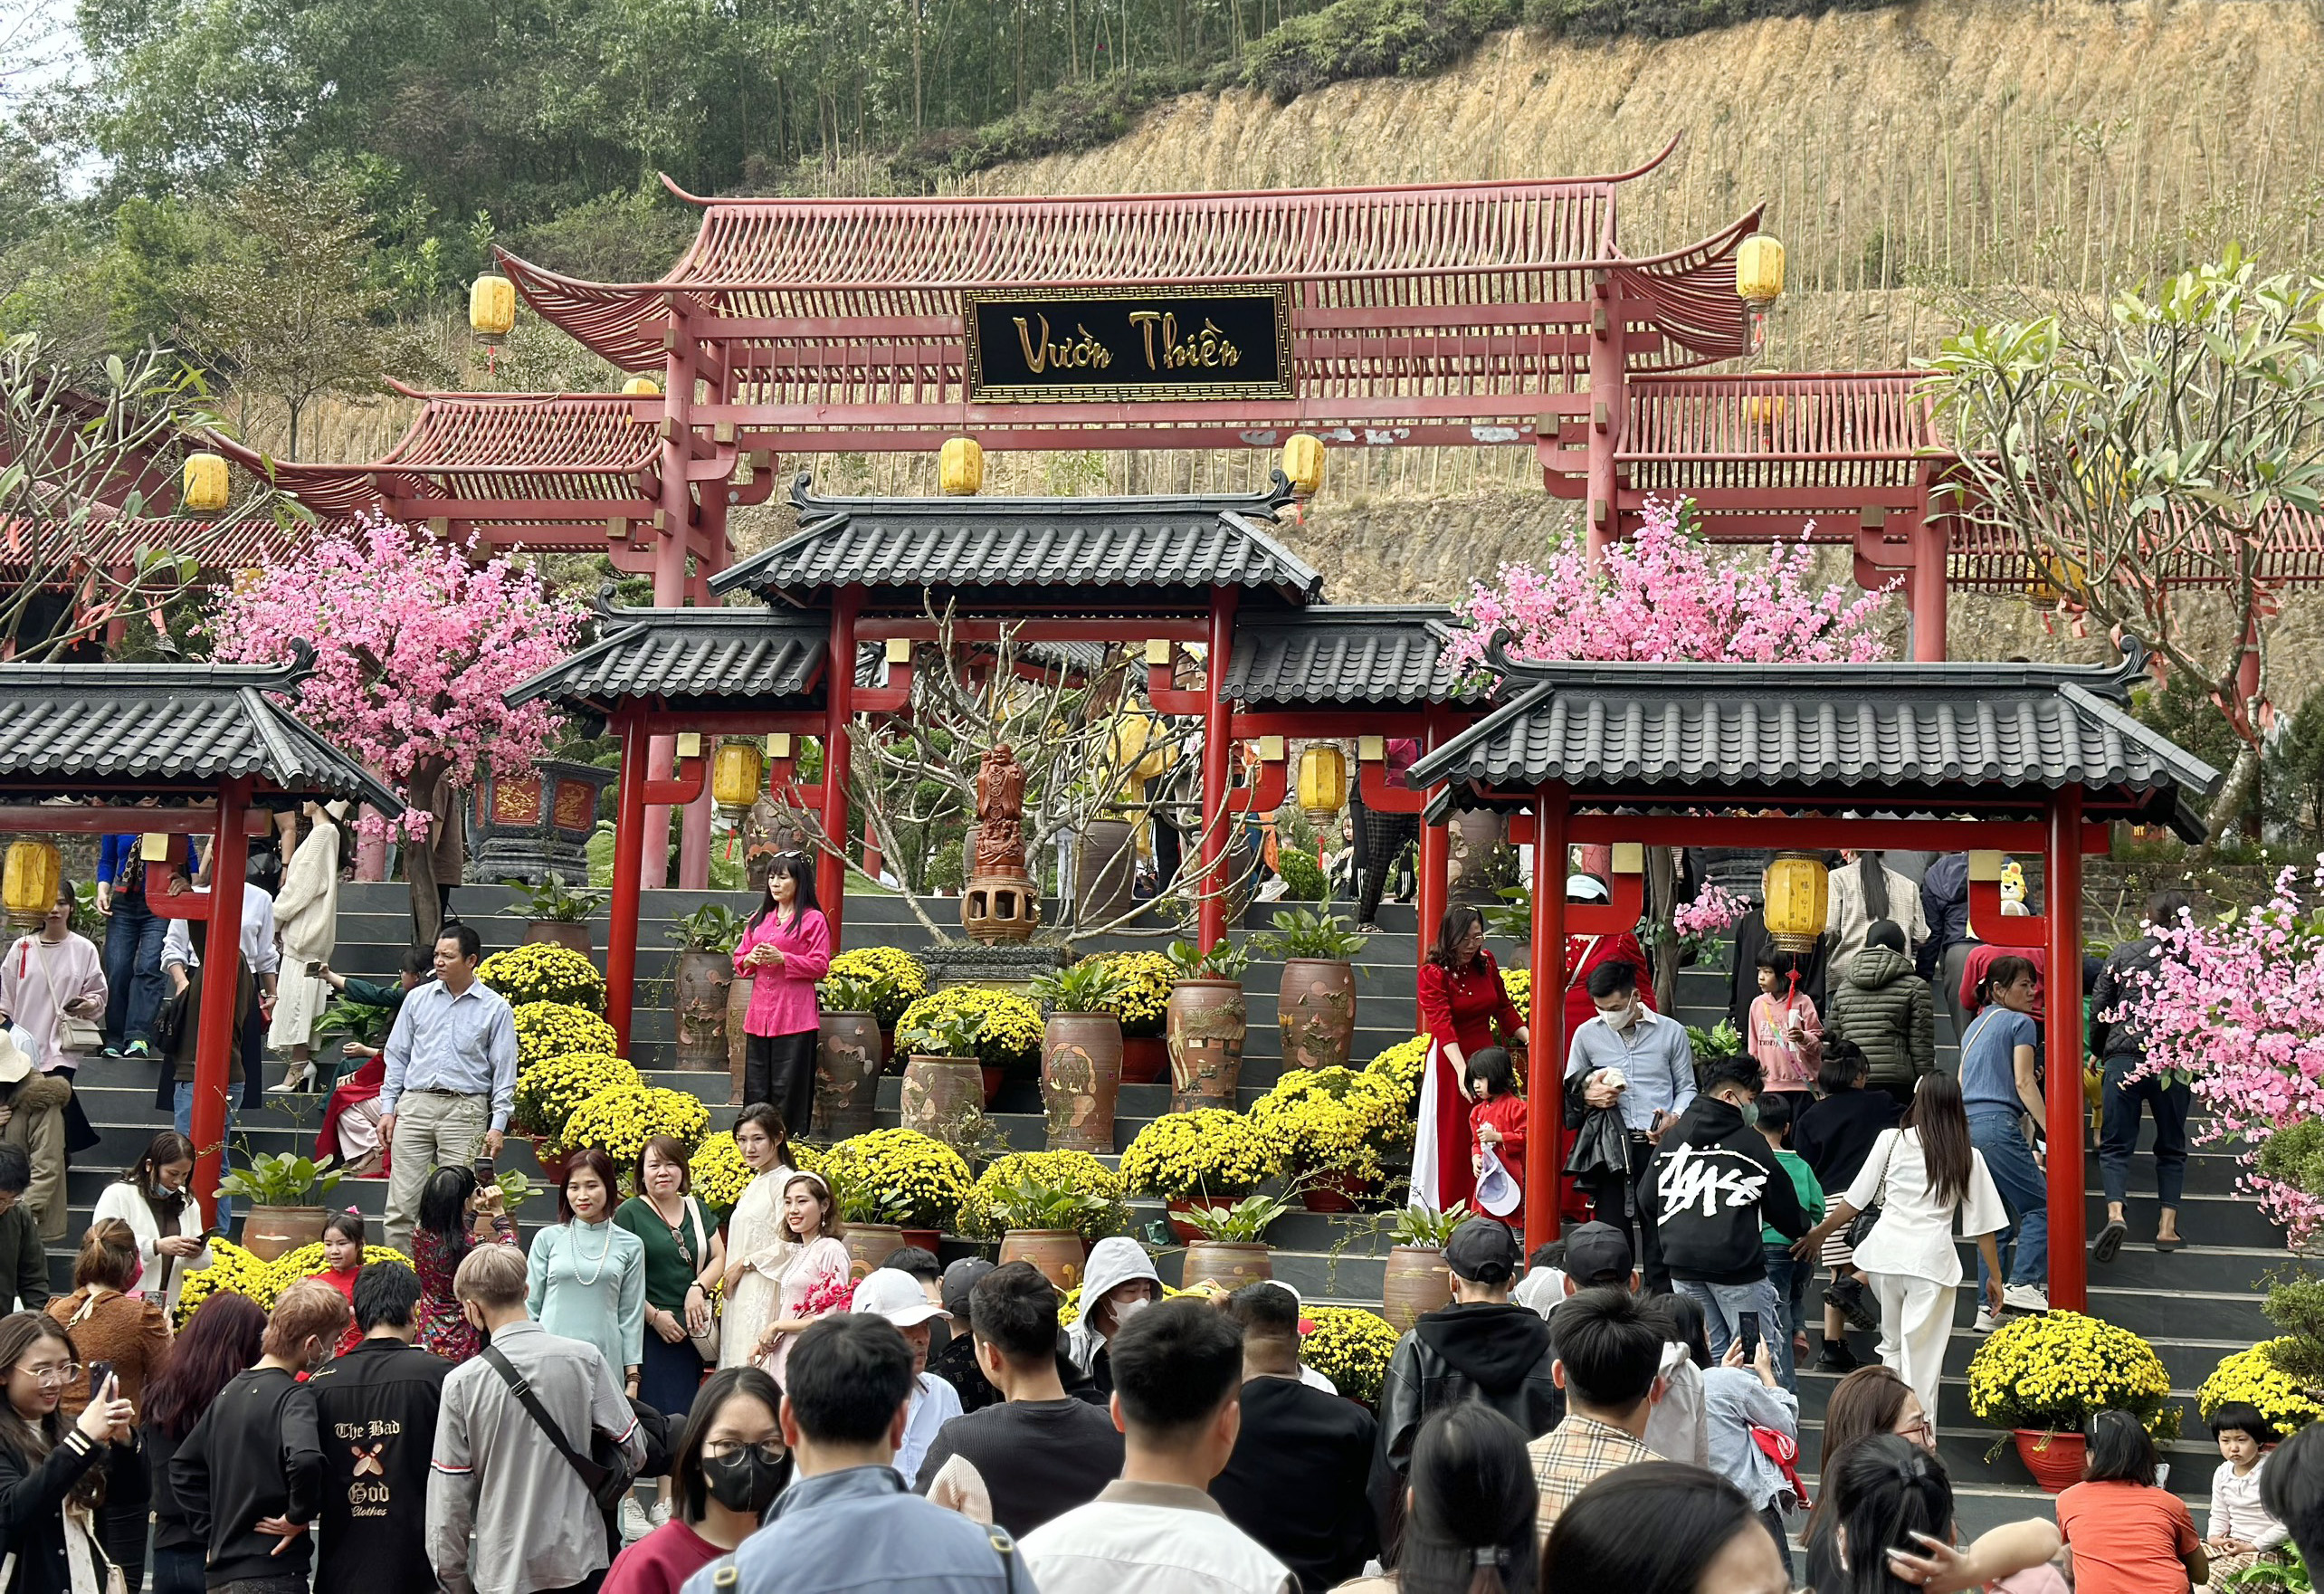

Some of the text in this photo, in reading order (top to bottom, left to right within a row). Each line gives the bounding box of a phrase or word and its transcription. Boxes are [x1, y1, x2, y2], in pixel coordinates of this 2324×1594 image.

[1012, 310, 1243, 374] Vườn Thiền
[334, 1419, 400, 1441] The Bad
[348, 1481, 390, 1504] God
[351, 1505, 387, 1517] Clothes
